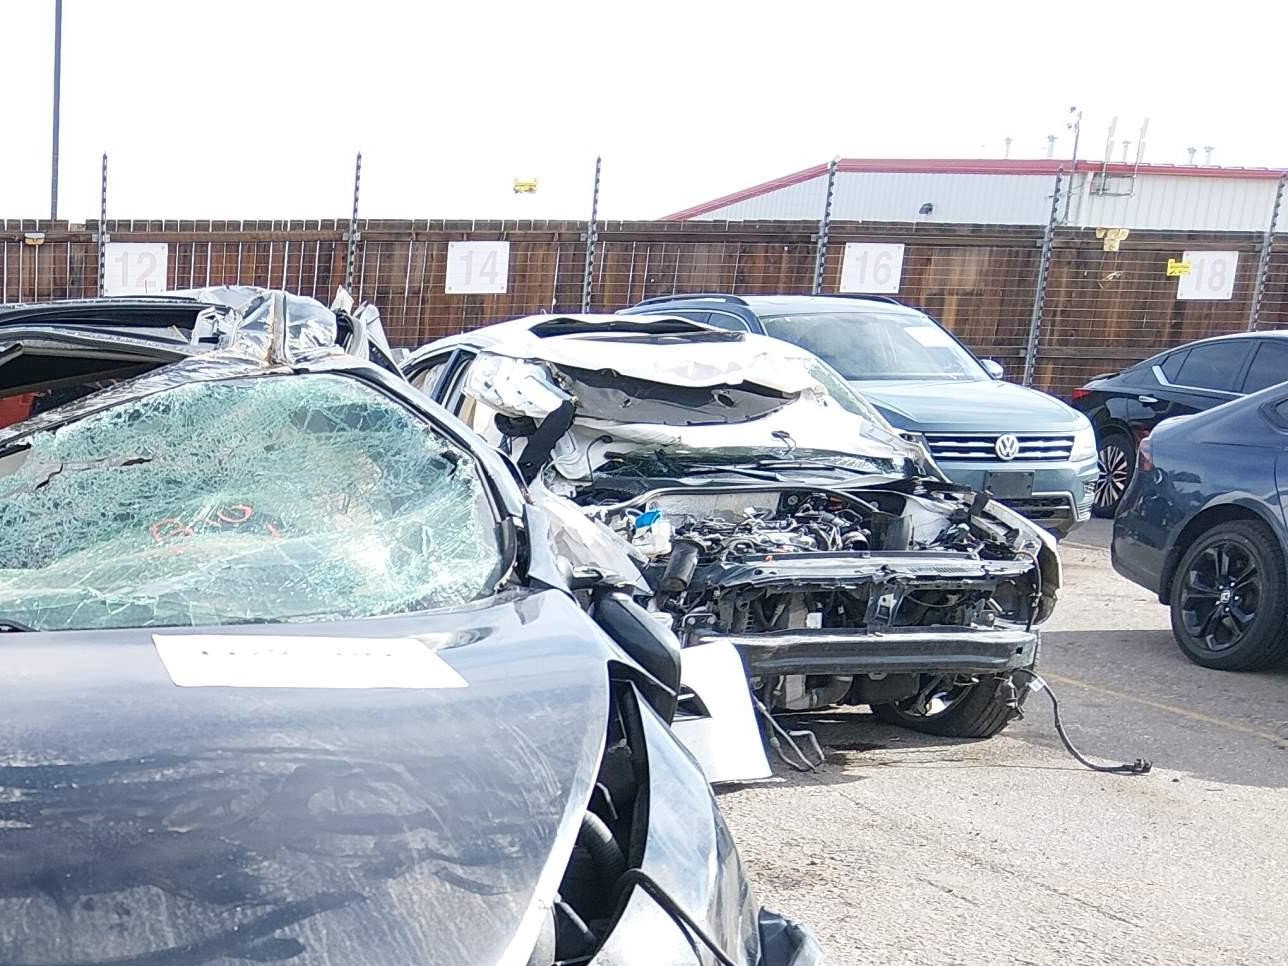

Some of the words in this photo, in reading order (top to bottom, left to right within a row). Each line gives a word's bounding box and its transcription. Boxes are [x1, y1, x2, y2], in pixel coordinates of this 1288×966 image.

[114, 250, 157, 288] 12
[459, 249, 499, 286] 14
[855, 250, 893, 286] 16
[1192, 258, 1227, 292] 18
